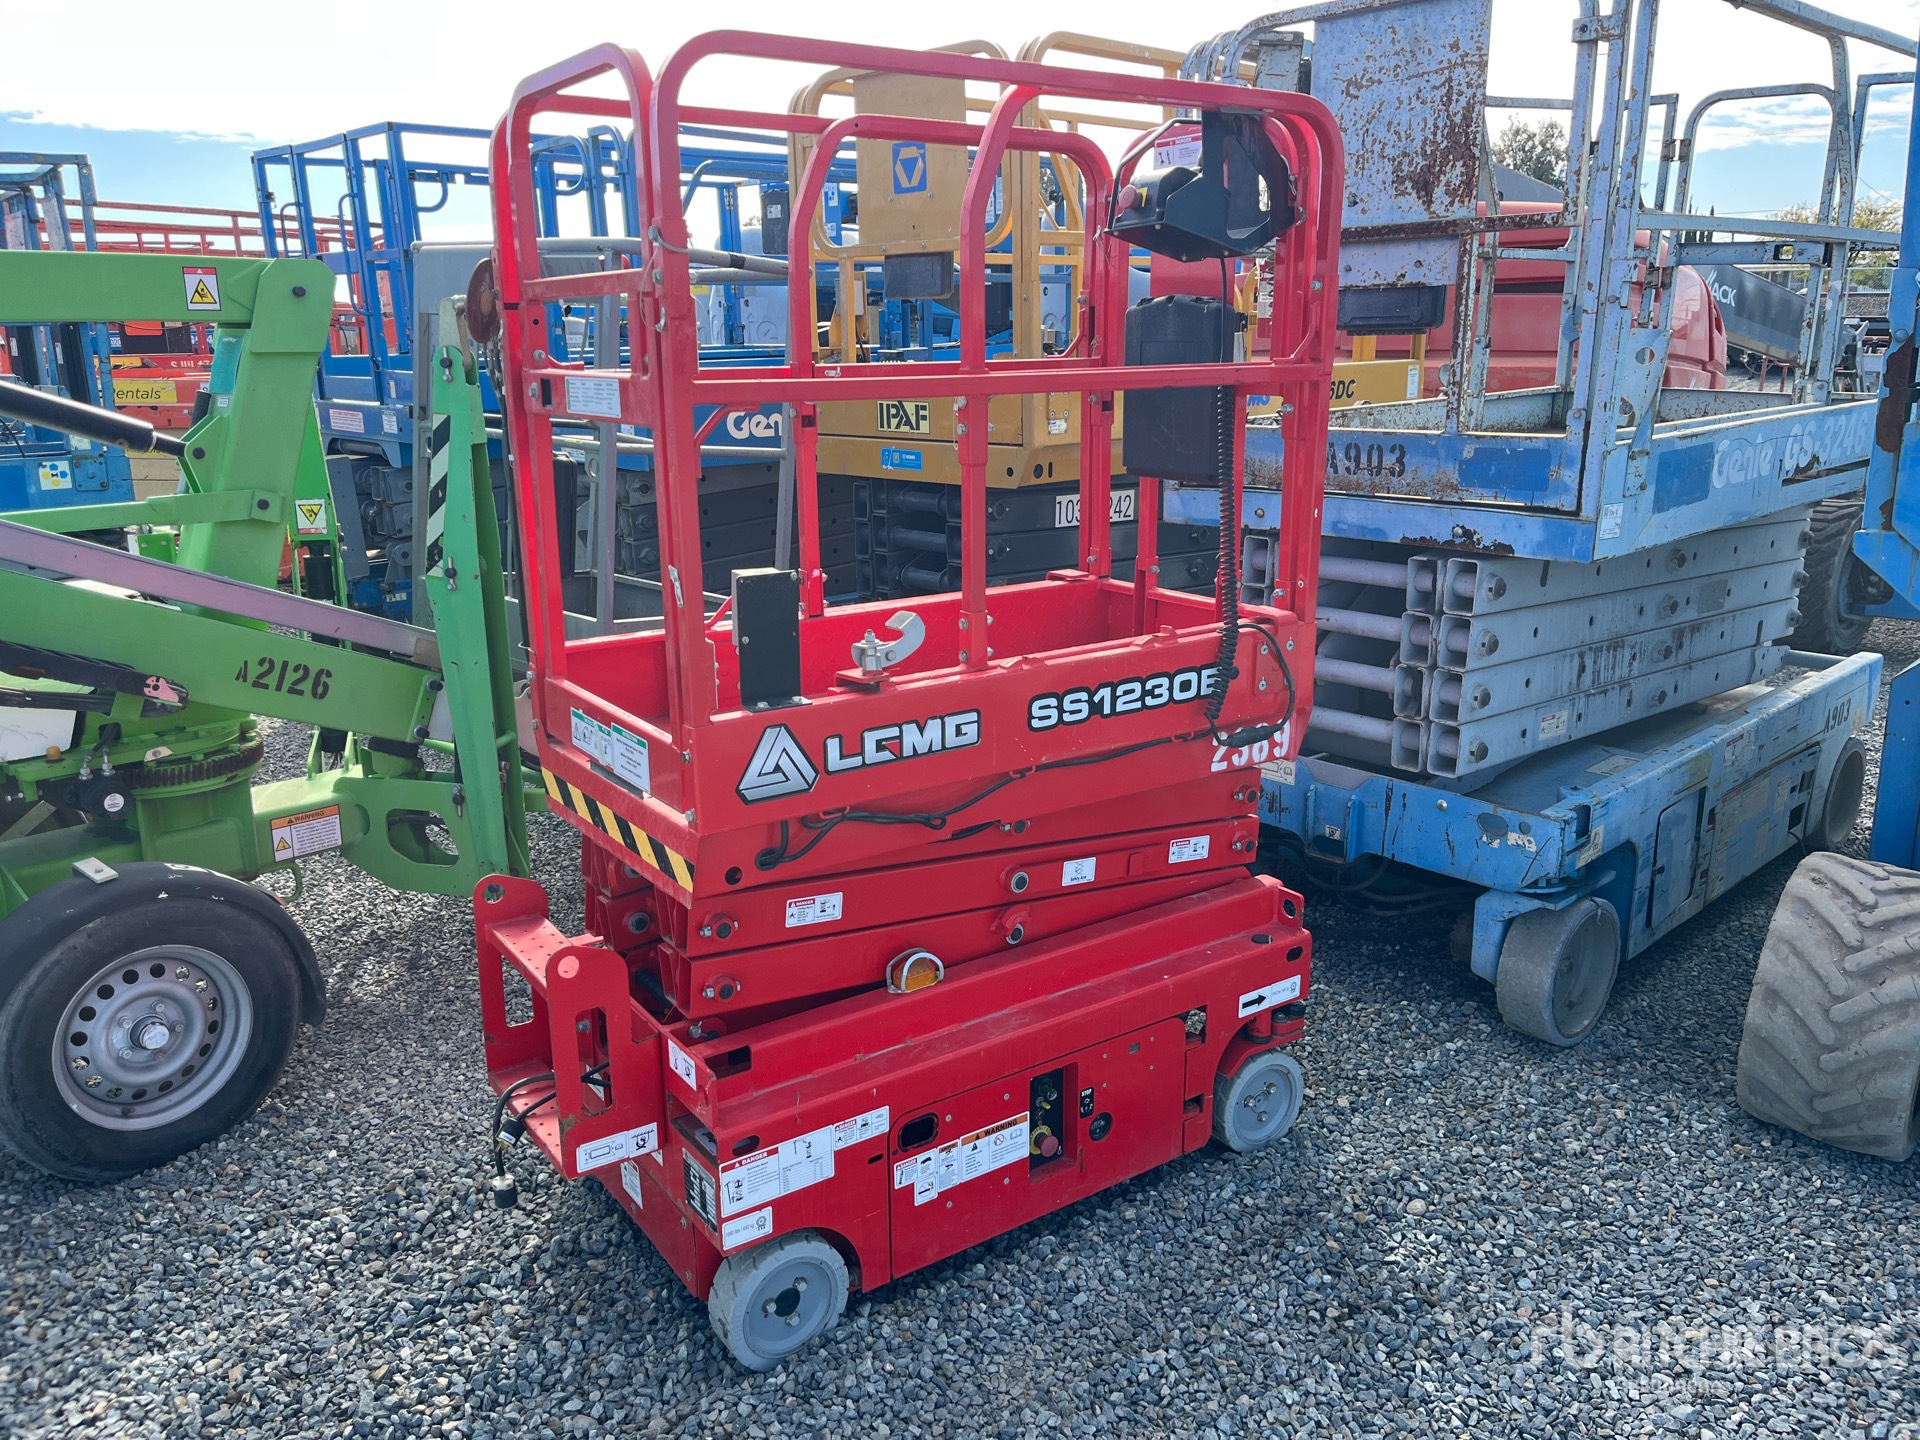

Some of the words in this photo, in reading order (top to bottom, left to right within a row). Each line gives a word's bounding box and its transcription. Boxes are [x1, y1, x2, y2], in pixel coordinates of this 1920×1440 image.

[113, 387, 161, 400] entals
[878, 400, 928, 431] IPAF
[1327, 441, 1406, 478] A903
[1711, 432, 1773, 489] Genie
[235, 656, 333, 700] A2126
[1823, 698, 1852, 734] A903
[294, 810, 325, 823] WARNING
[1081, 1088, 1092, 1097] STOP
[983, 1118, 1018, 1137] WARNING
[741, 1151, 768, 1166] DANGER
